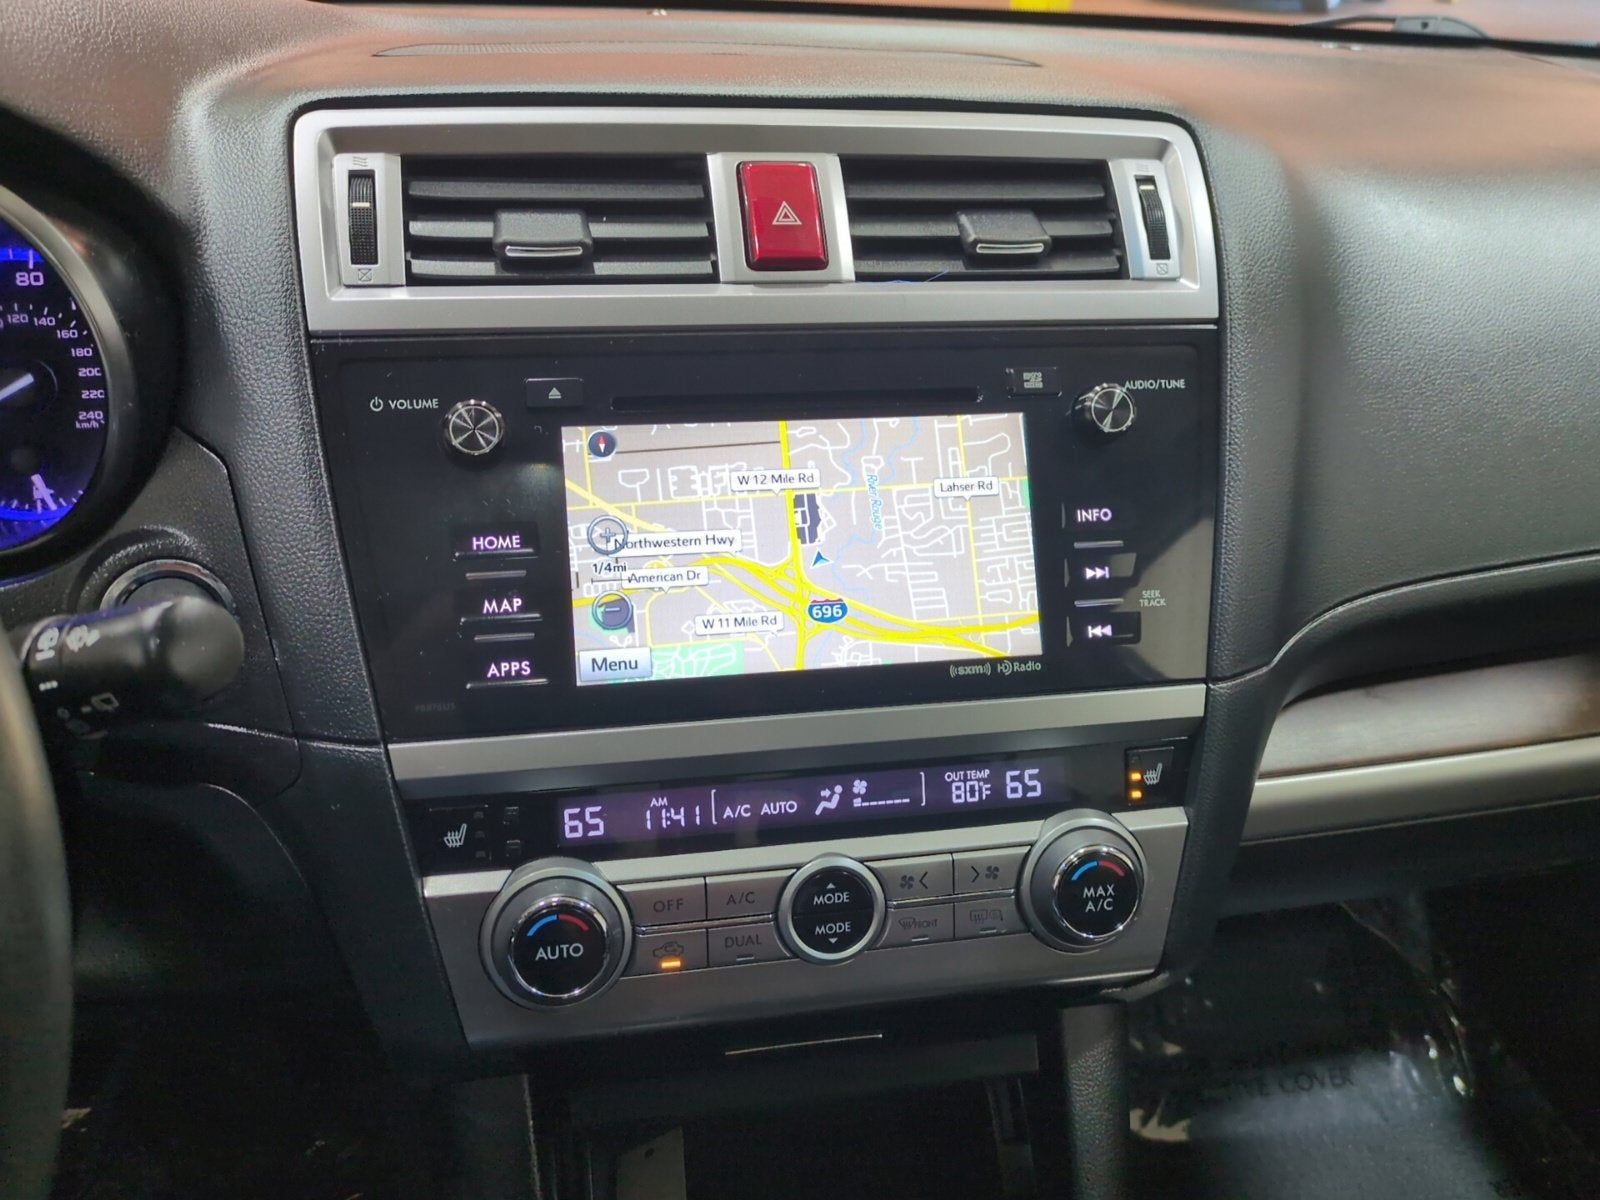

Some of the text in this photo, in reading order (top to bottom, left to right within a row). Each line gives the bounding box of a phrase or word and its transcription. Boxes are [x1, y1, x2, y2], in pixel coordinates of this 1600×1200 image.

[16, 272, 44, 286] 80
[7, 314, 29, 323] 120
[33, 317, 56, 326] 140
[56, 329, 78, 339] 160
[71, 348, 93, 357] 180
[1124, 379, 1186, 391] AUDIO/TUNE
[389, 398, 439, 410] VOLUME
[79, 411, 104, 420] 240
[737, 472, 814, 485] W 12 Mile Rd
[940, 481, 994, 493] Lahser Rd
[866, 474, 883, 529] River Rouge
[1077, 508, 1112, 523] INFO
[472, 535, 521, 550] HOME
[614, 534, 735, 550] Northwestern Hwy
[630, 570, 701, 583] American Dr
[1142, 590, 1160, 598] SEEK
[482, 598, 522, 614] MAP
[1139, 598, 1166, 607] TRACK
[812, 605, 843, 619] 696
[702, 615, 778, 629] W 11 Mile Rd
[487, 661, 531, 678] APPS
[591, 656, 639, 673] Menu
[1013, 661, 1041, 672] Radio
[944, 769, 990, 782] OUT TEMP
[1006, 769, 1041, 799] 65
[650, 797, 668, 807] AM
[723, 800, 798, 819] A/C AUTO
[563, 806, 604, 839] 65
[646, 805, 701, 830] 11:41
[813, 891, 850, 905] MODE
[1084, 884, 1115, 898] MAX
[653, 899, 684, 913] OFF
[726, 892, 755, 906] A/C
[1085, 899, 1113, 913] A/C
[815, 921, 851, 935] MODE
[724, 934, 762, 948] DUAL
[535, 943, 584, 961] AUTO
